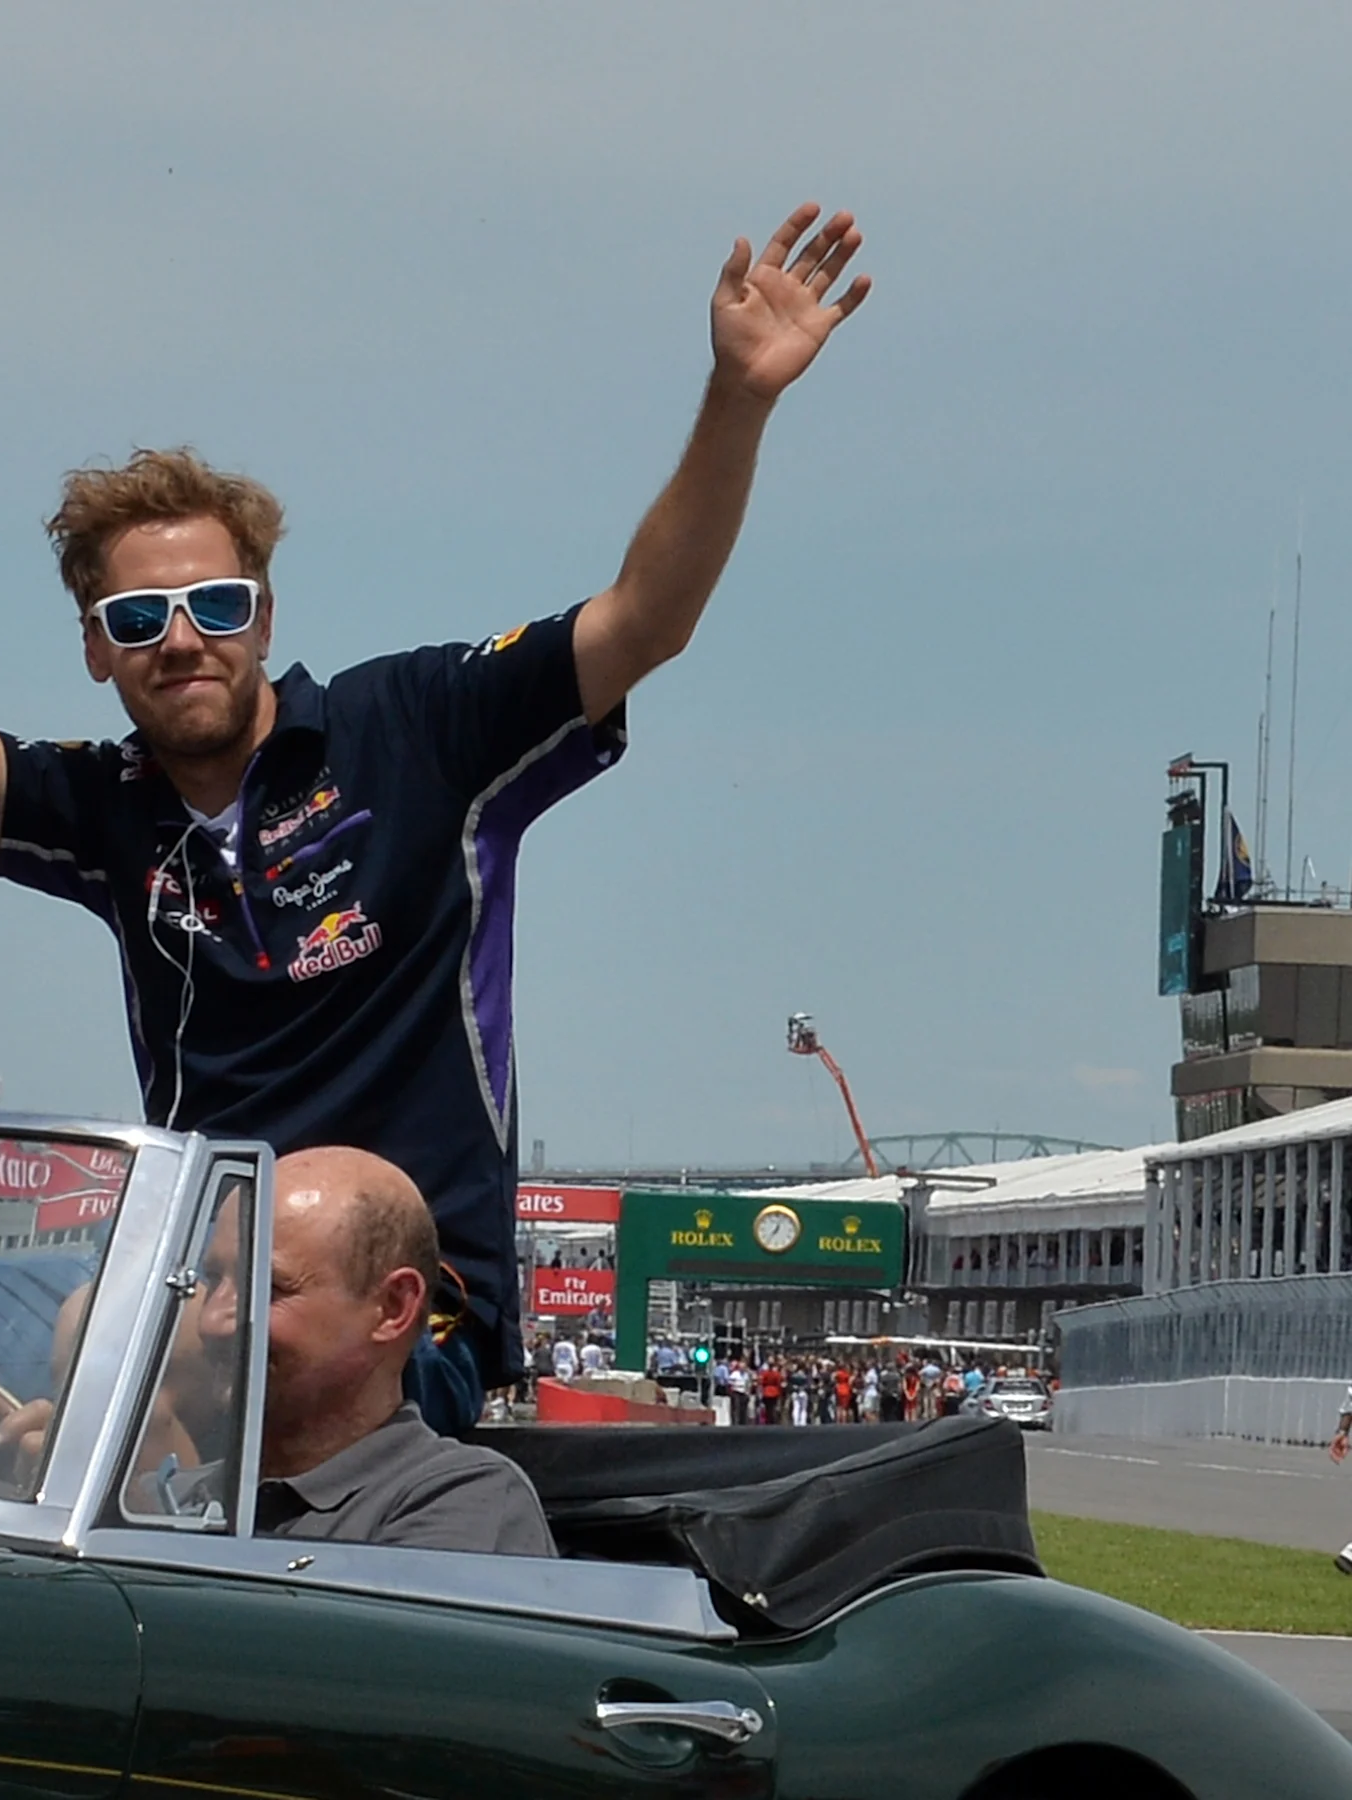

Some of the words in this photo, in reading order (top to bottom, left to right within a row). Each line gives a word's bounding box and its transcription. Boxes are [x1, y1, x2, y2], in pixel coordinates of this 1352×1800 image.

[288, 941, 339, 982] Red
[334, 922, 383, 966] Bull
[517, 1193, 565, 1214] ates
[670, 1230, 734, 1247] ROLEX
[818, 1236, 882, 1253] ROLEX
[564, 1276, 587, 1291] Fly
[538, 1288, 613, 1306] Emirates
